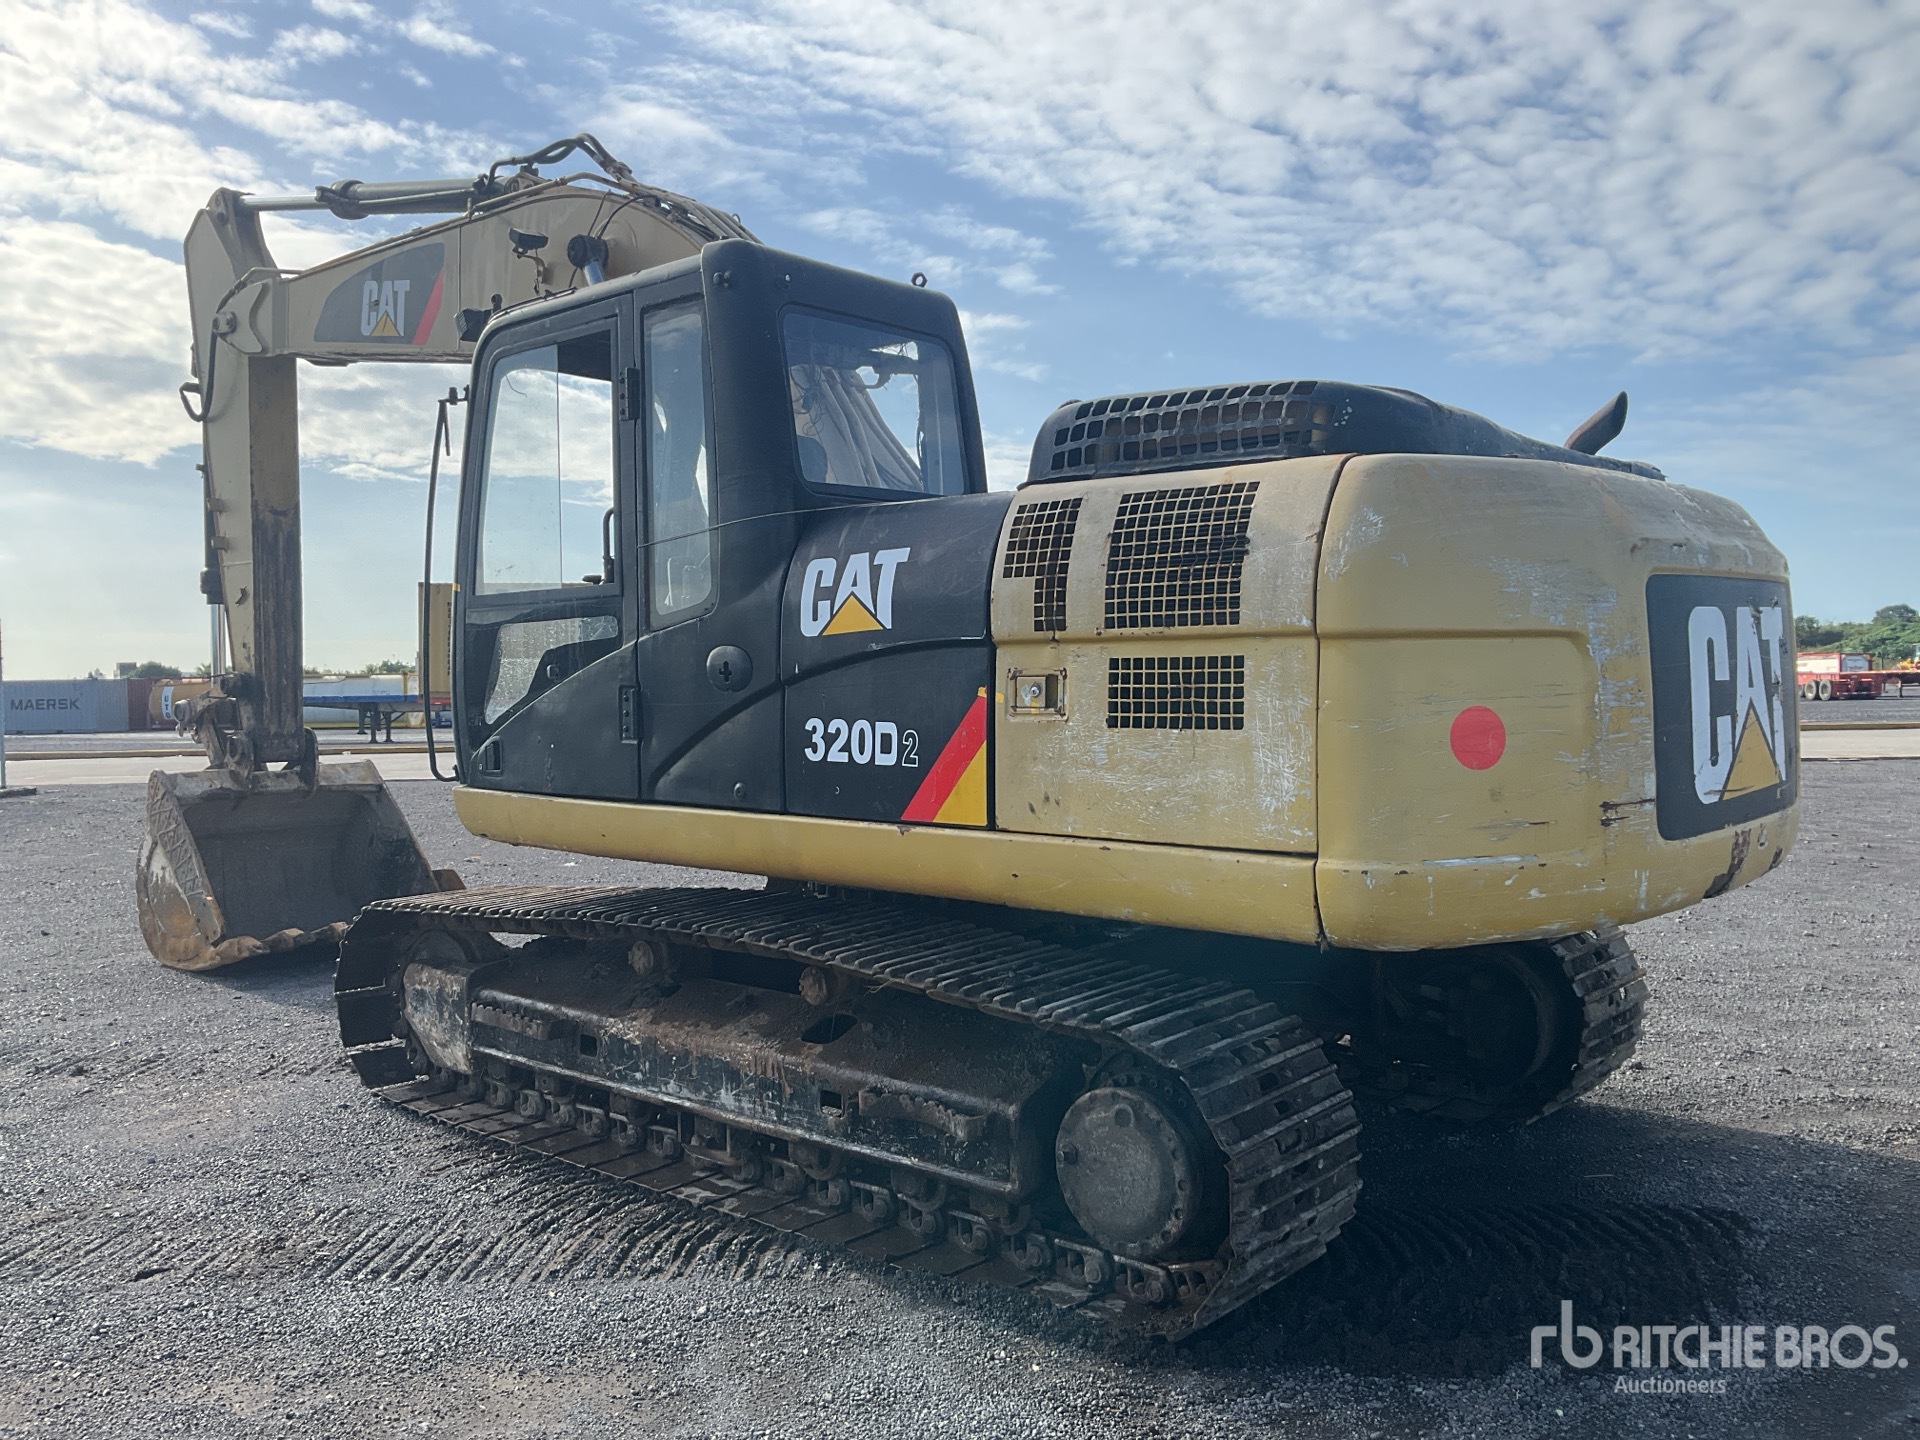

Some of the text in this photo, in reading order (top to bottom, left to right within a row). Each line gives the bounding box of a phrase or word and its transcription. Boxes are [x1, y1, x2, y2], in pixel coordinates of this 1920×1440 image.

[361, 280, 410, 337] CAT
[800, 547, 911, 637] CAT
[10, 698, 80, 711] MAERSK
[1688, 606, 1787, 805] CAT
